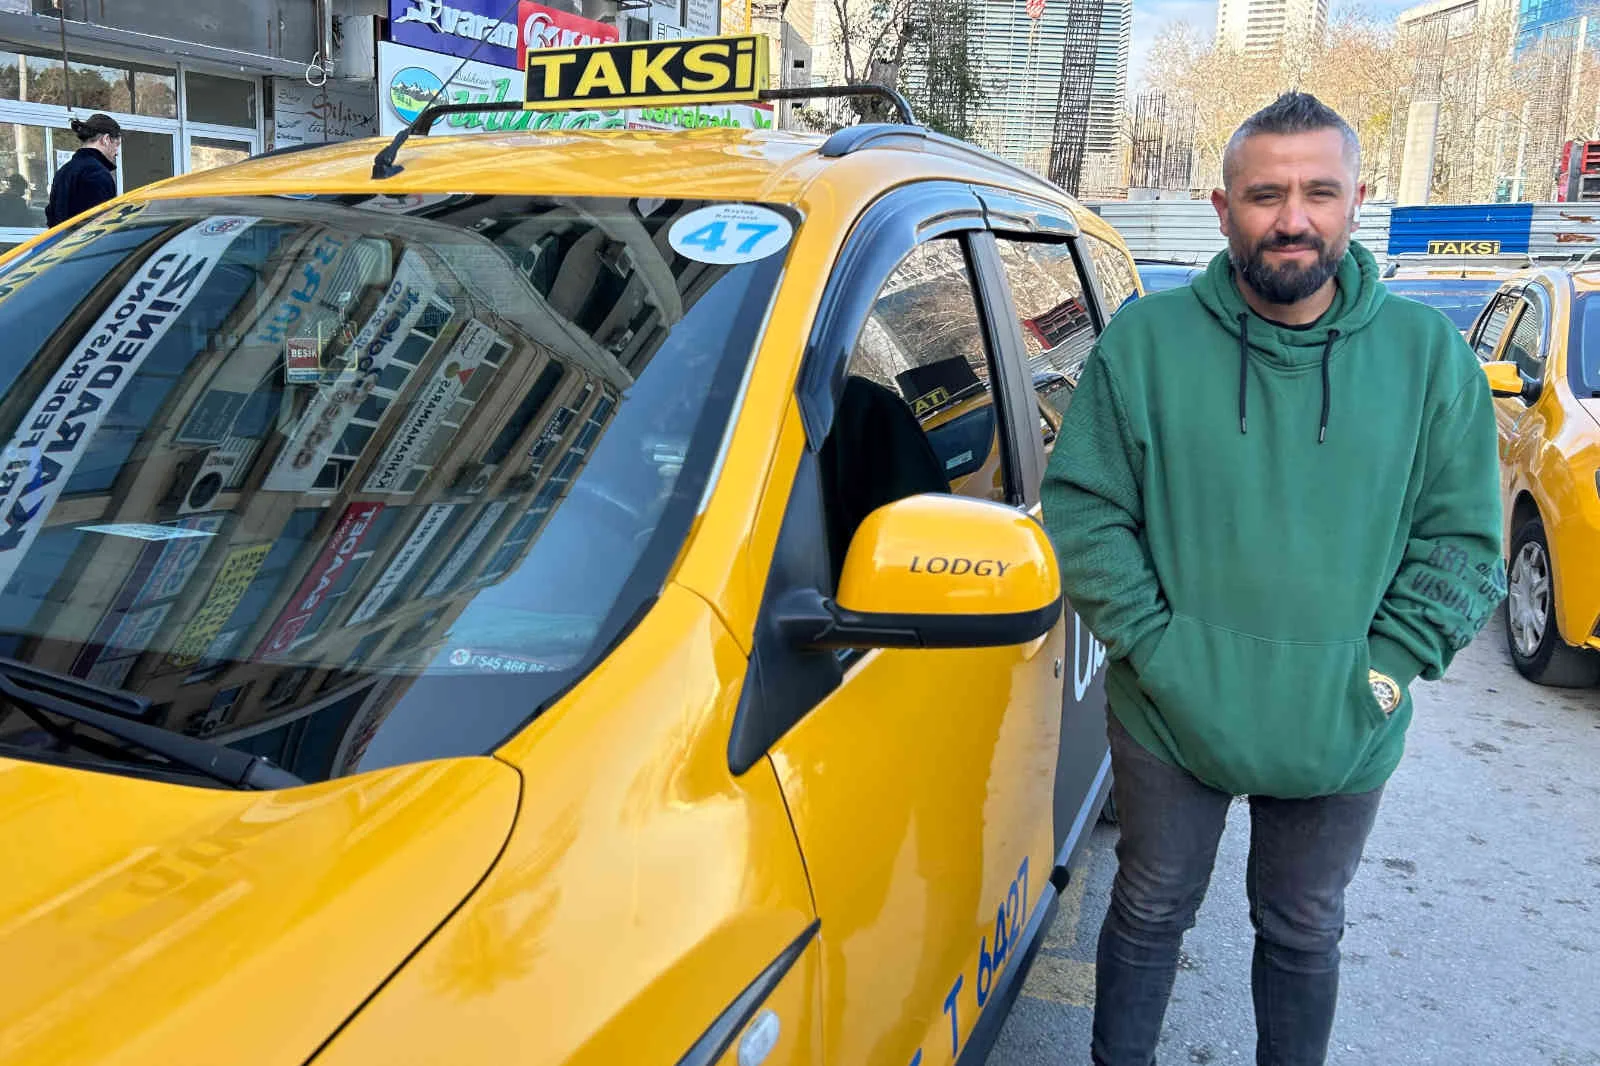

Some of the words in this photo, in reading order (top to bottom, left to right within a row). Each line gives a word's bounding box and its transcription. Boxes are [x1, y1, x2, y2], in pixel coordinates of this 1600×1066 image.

[680, 220, 779, 255] 47
[909, 556, 1012, 577] LODGY
[944, 973, 964, 1059] T
[977, 855, 1029, 1008] 6427
